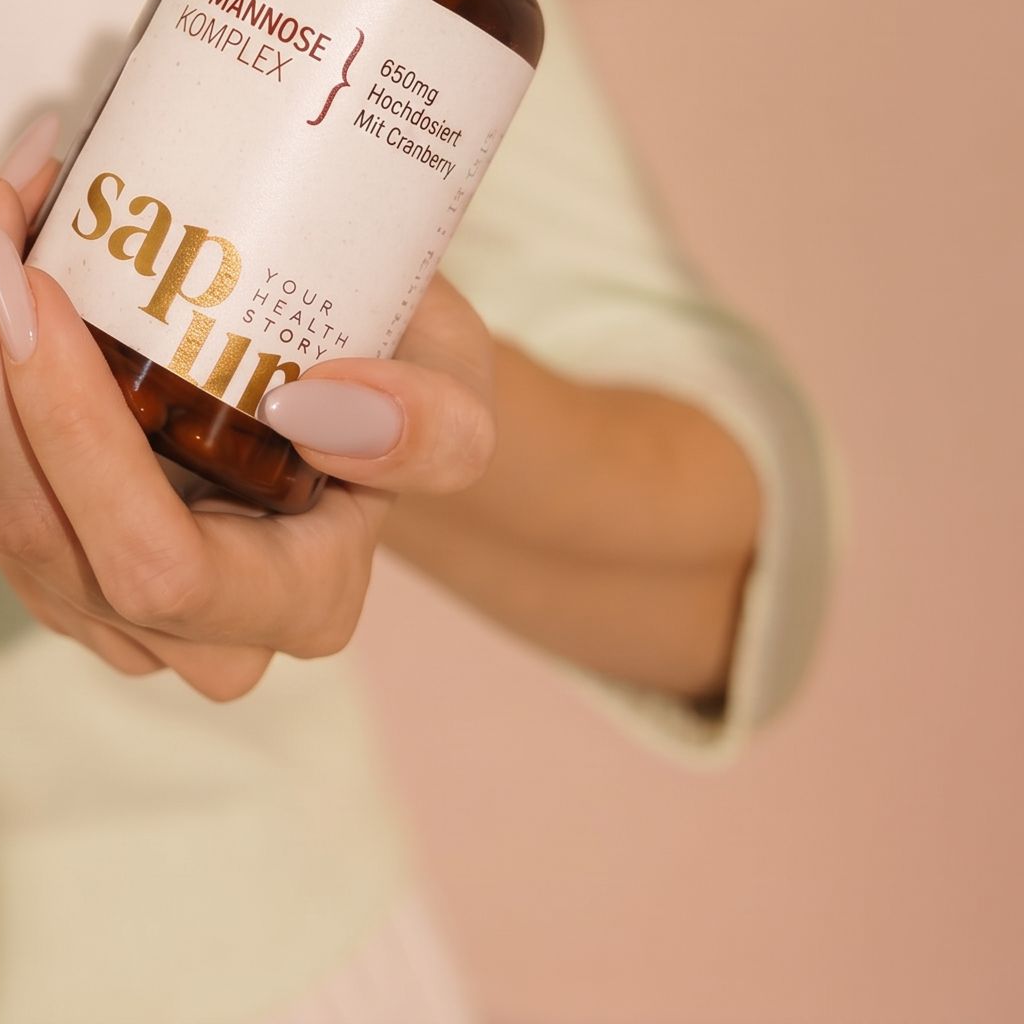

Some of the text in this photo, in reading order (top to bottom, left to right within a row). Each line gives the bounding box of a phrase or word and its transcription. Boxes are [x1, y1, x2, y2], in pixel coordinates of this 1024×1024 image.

[176, 4, 294, 83] KOMPLEX
[380, 59, 440, 106] 650mg
[353, 109, 386, 138] Mit
[386, 127, 457, 181] Cranberry
[367, 83, 463, 147] Hochdosiert
[71, 172, 242, 325] sap
[253, 288, 350, 349] HEALTH
[266, 268, 333, 316] YOUR
[242, 309, 328, 360] STORY
